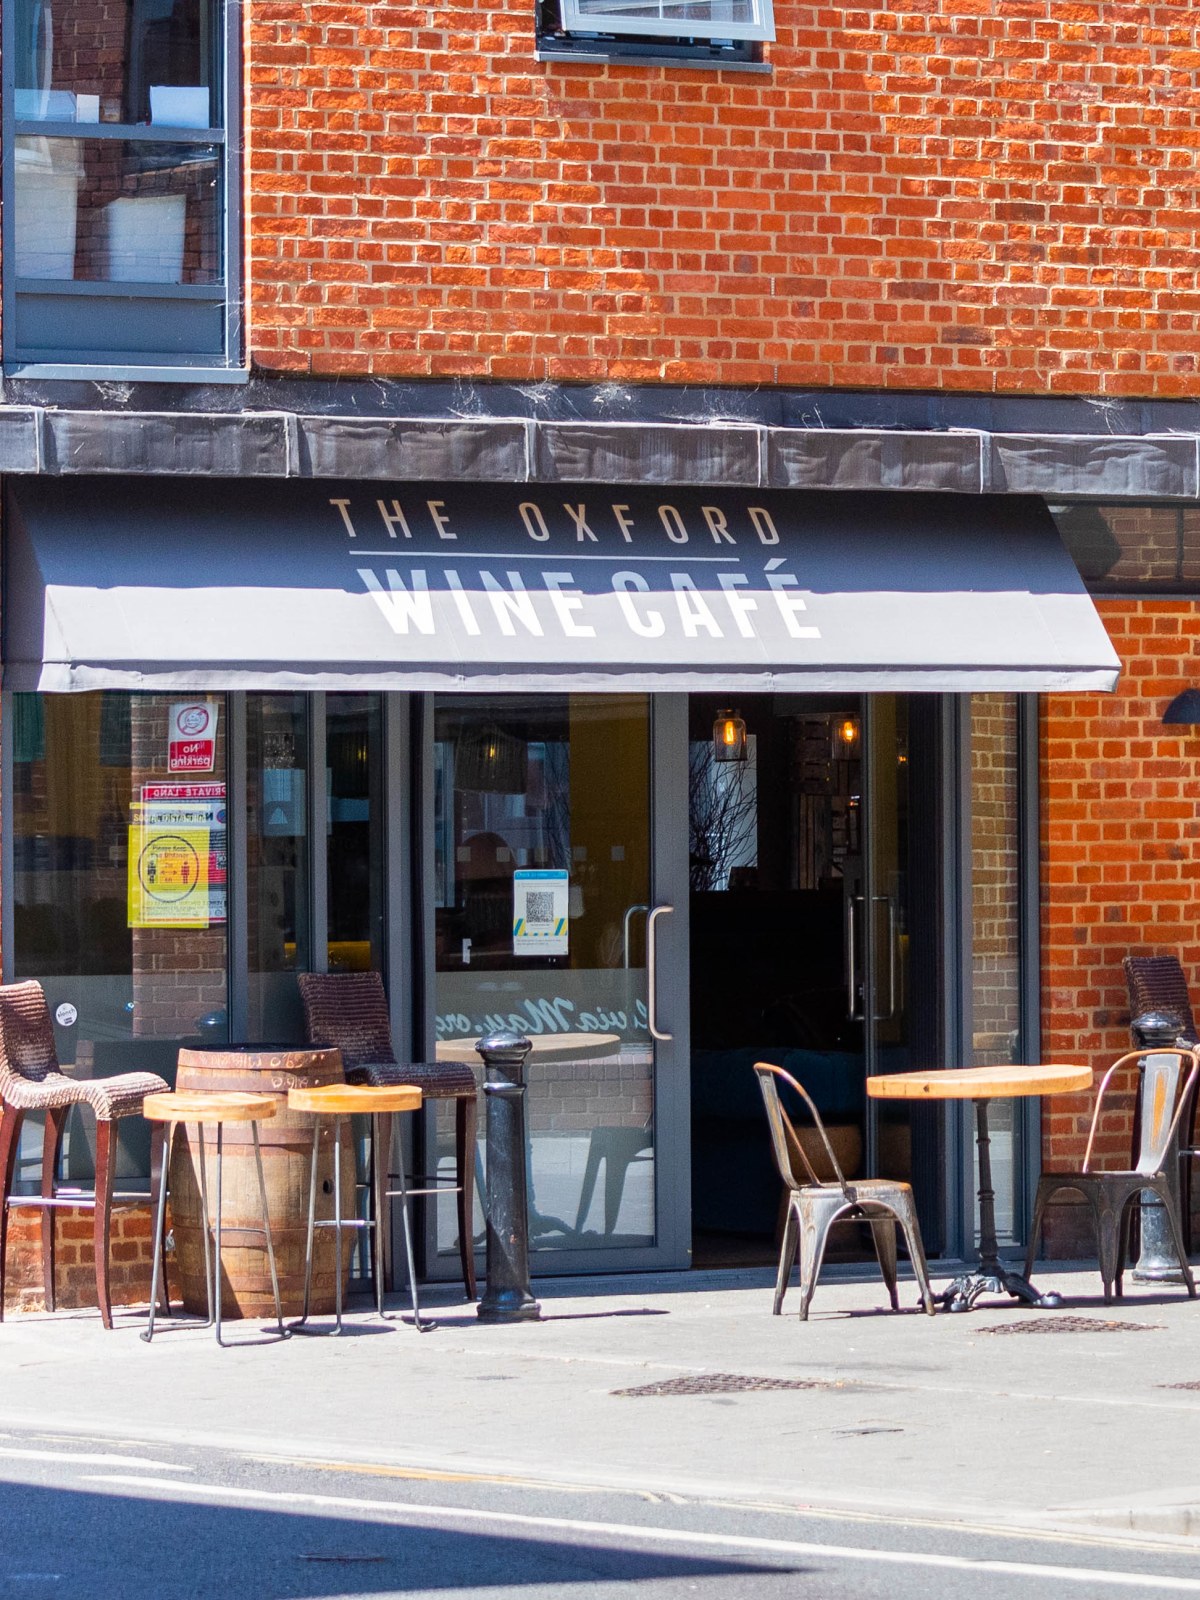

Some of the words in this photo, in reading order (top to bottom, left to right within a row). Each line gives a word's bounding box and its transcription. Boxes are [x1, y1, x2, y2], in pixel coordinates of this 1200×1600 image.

[330, 498, 457, 540] THE
[518, 502, 780, 545] OXFORD
[356, 568, 598, 637] WINE
[611, 558, 822, 638] CAFÉ
